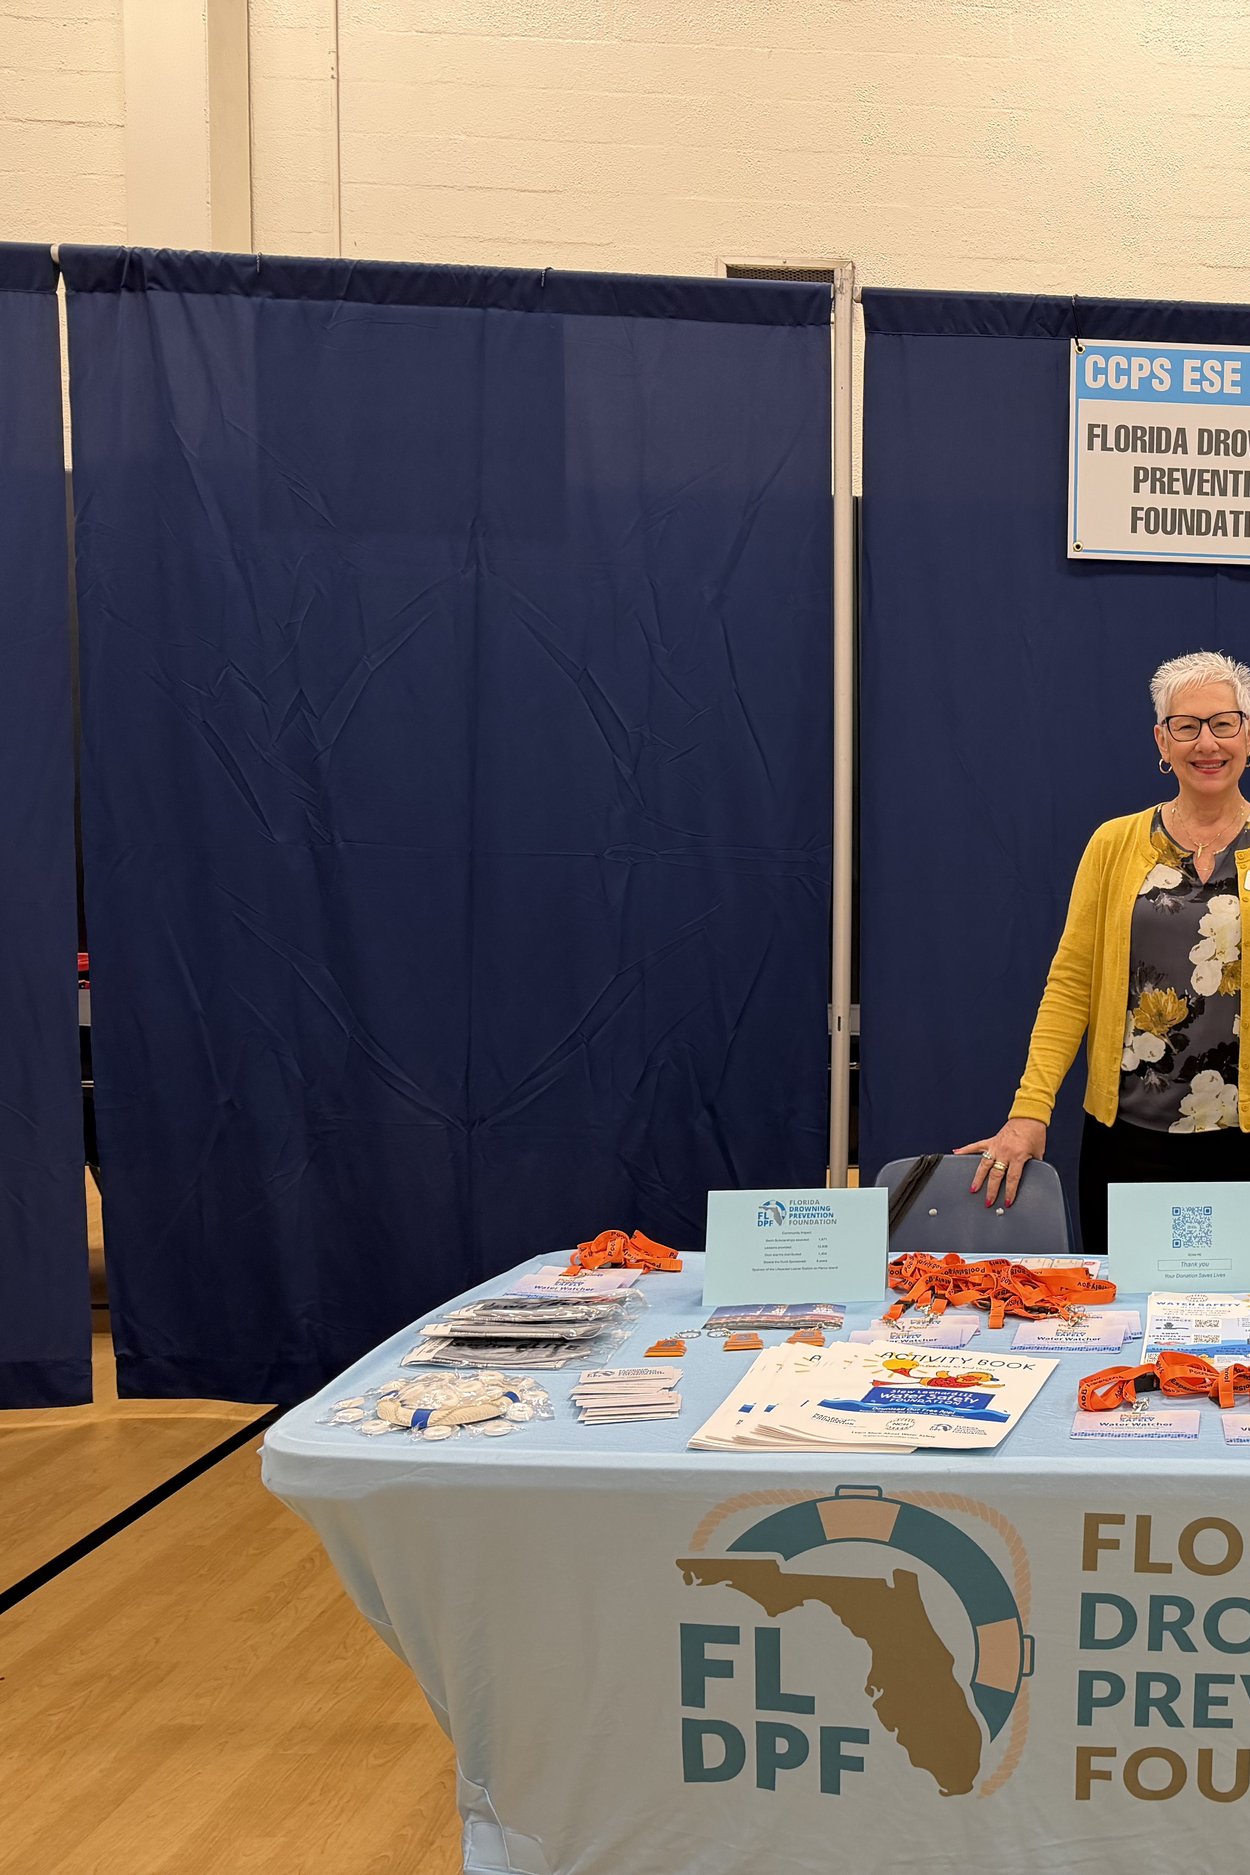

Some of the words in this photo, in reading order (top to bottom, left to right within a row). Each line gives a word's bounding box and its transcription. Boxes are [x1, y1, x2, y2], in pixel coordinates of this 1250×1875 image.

[1084, 354, 1172, 392] CCPS
[1182, 358, 1242, 394] ESE
[1086, 423, 1188, 456] FLORIDA
[758, 1212, 769, 1220] FL
[879, 1352, 972, 1365] ACTIVITY
[978, 1359, 1036, 1371] BOOK
[880, 1392, 924, 1400] Water
[926, 1393, 979, 1404] Safety
[890, 1398, 961, 1406] FOUNDATION
[680, 1622, 815, 1715] FL
[681, 1717, 870, 1796] DPF
